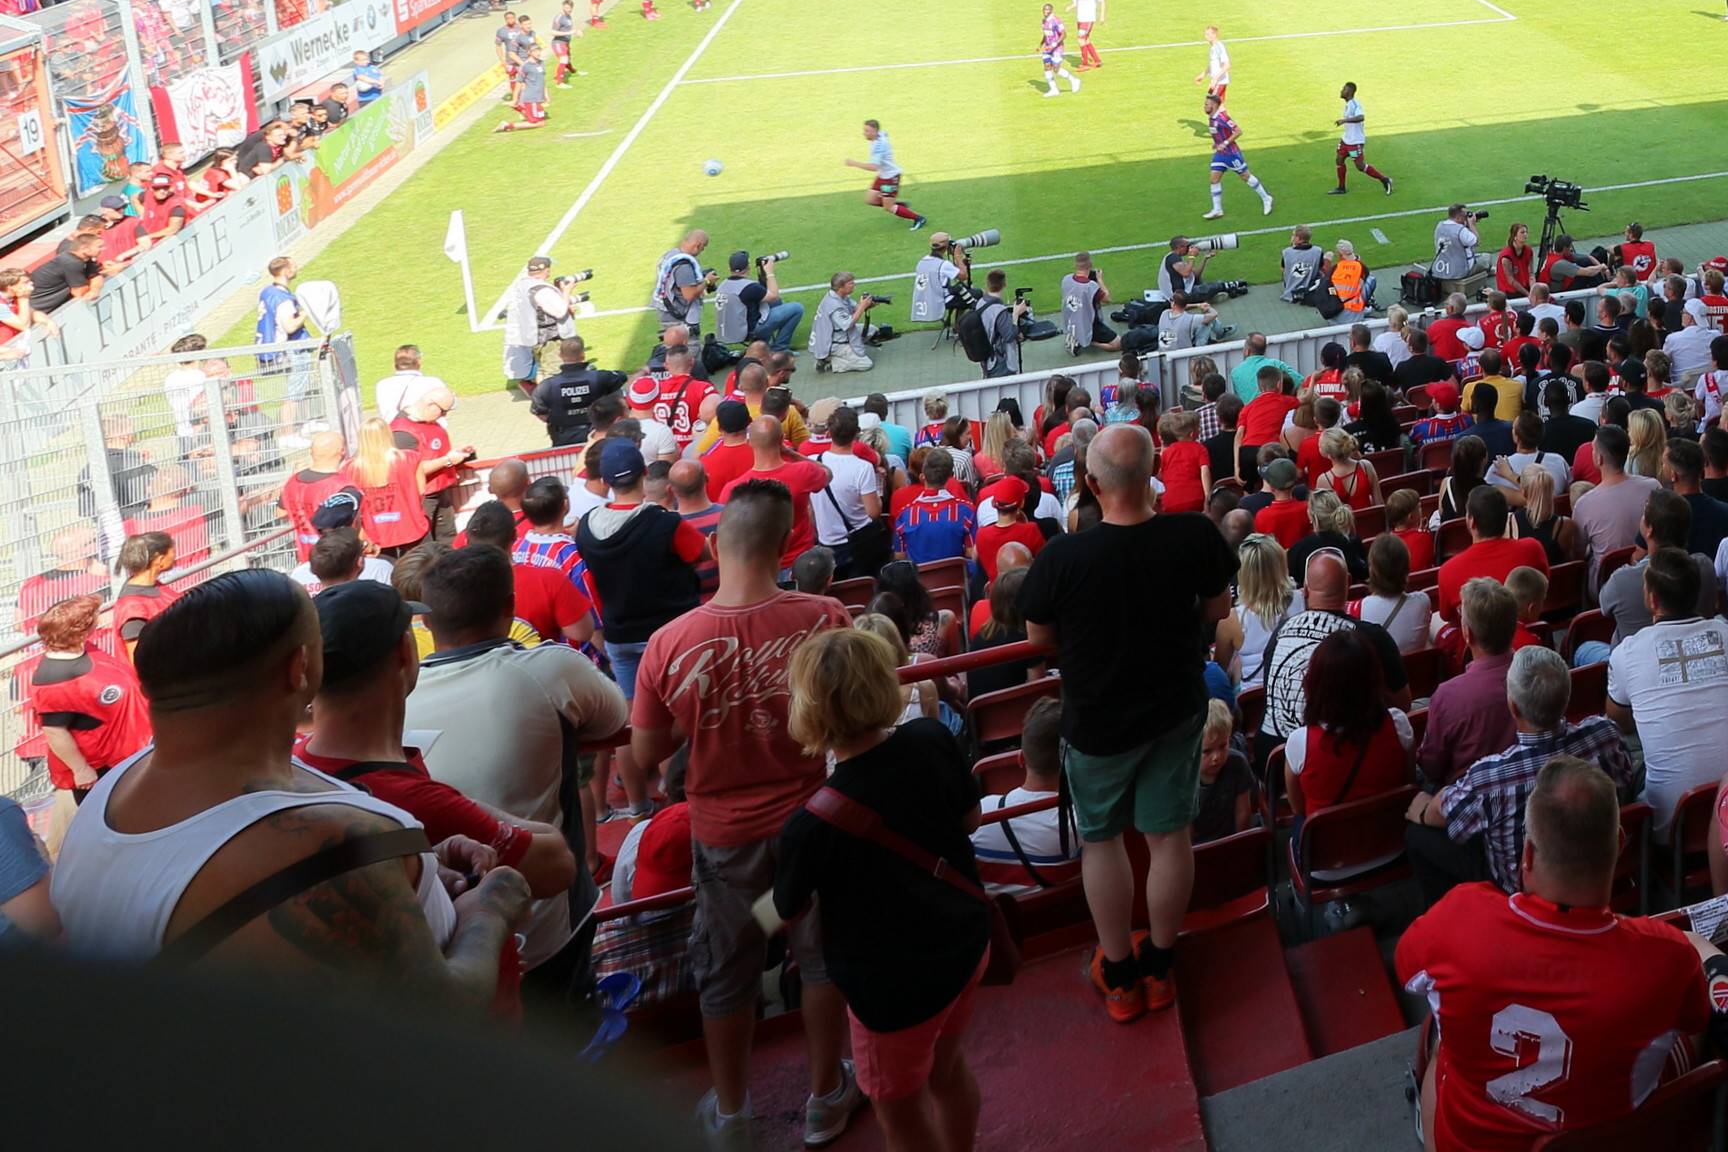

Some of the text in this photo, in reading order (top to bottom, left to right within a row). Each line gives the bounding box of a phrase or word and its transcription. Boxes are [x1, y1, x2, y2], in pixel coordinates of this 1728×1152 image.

[290, 20, 350, 67] Wernecke
[23, 118, 39, 146] 19
[1435, 259, 1450, 275] 01
[92, 213, 234, 352] FIENILE
[560, 385, 590, 397] POLIZEI
[1284, 615, 1357, 634] BOXING
[1485, 1002, 1573, 1130] 2
